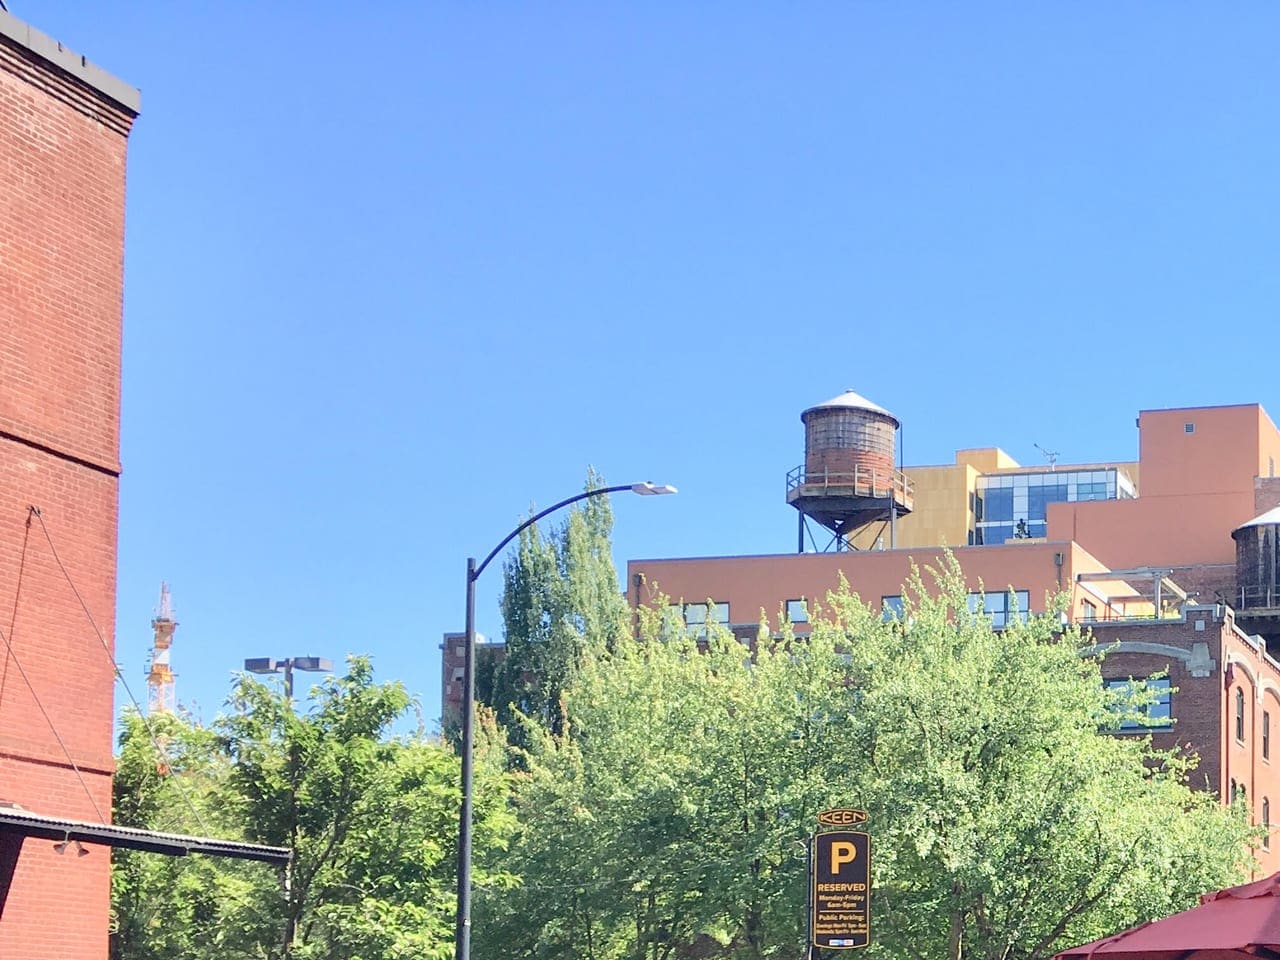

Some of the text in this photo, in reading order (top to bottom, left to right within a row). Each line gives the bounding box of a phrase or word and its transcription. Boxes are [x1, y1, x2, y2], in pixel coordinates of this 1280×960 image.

[820, 811, 866, 824] KEEN
[831, 841, 856, 874] P
[818, 883, 866, 892] RESERVED
